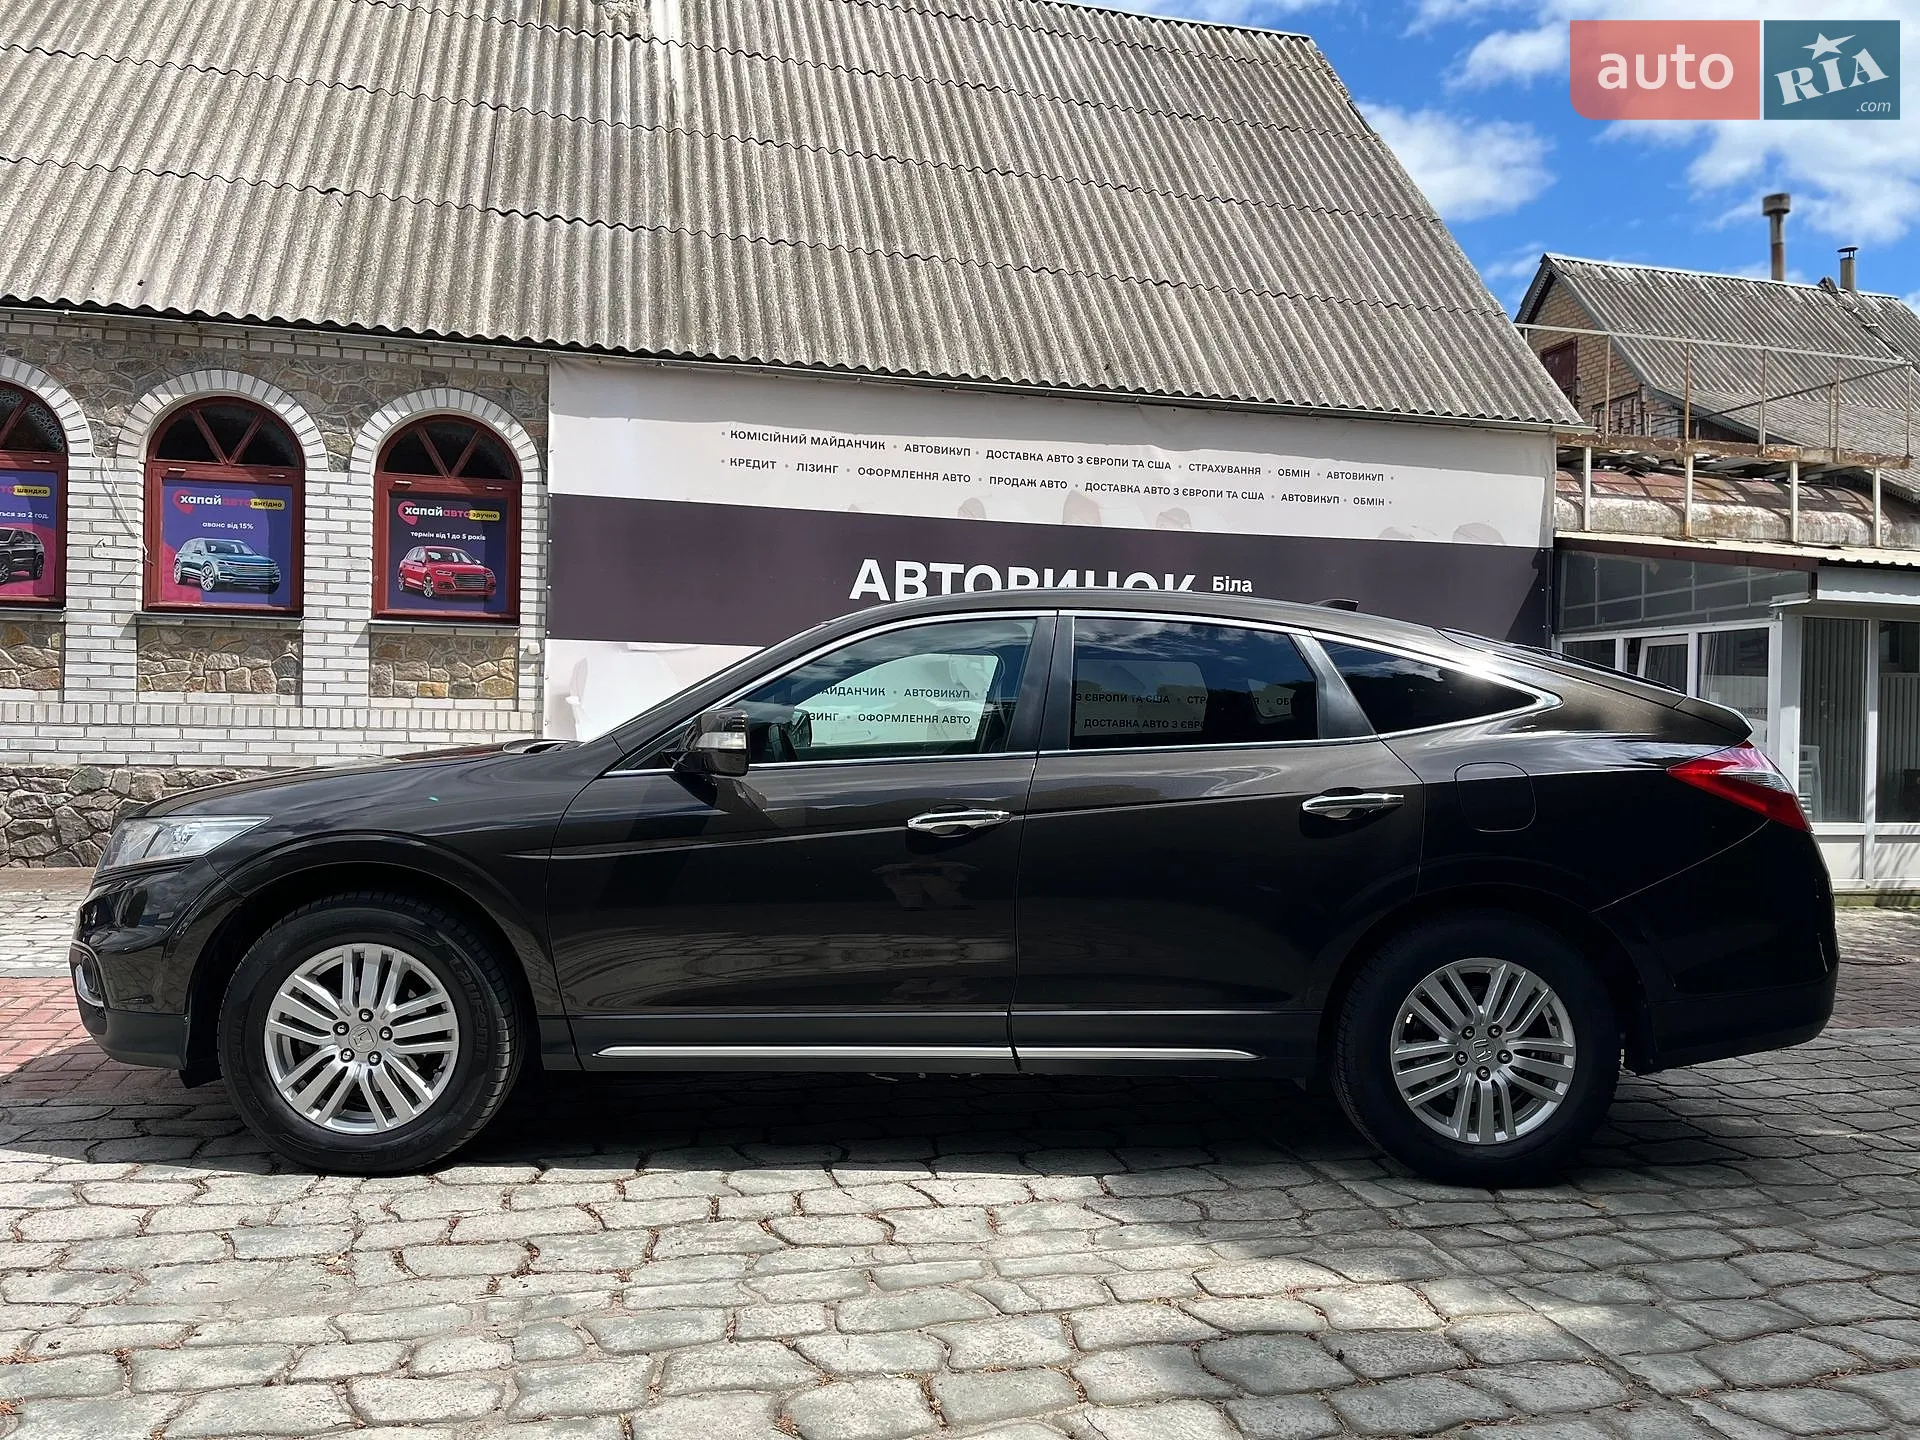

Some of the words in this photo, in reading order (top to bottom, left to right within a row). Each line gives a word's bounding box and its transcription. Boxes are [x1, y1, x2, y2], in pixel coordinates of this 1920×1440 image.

[730, 430, 807, 445] КОМІСІЙНИЙ
[811, 436, 886, 450] МАЙДАНЧИК
[904, 443, 971, 457] АВТОВИКУП
[986, 449, 1043, 462] ДОСТАВКА
[1046, 454, 1074, 464] АВТО
[1077, 455, 1084, 464] З
[1086, 456, 1129, 468] ЄВРОПИ
[1132, 459, 1145, 469] ТА
[1147, 460, 1171, 470] США
[1188, 463, 1261, 476] СТРАХУВАННЯ
[1277, 468, 1310, 478] ОБМІН
[1326, 471, 1384, 482] АВТОВИКУП
[730, 457, 776, 470] КРЕДИТ
[796, 462, 839, 474] ЛІЗИНГ
[857, 466, 939, 481] ОФОРМЛЕННЯ
[942, 473, 971, 483] АВТО
[989, 476, 1037, 488] ПРОДАЖ
[1040, 479, 1068, 489] АВТО
[1085, 482, 1141, 494] ДОСТАВКА
[1143, 485, 1170, 496] АВТО
[1173, 487, 1180, 496] З
[1182, 487, 1223, 498] ЄВРОПИ
[1226, 490, 1238, 499] ТА
[1241, 491, 1265, 501] США
[1280, 493, 1340, 504] АВТОВИКУП
[1353, 497, 1385, 506] ОБМІН
[227, 522, 238, 530] від
[240, 522, 254, 530] 15%
[435, 531, 446, 539] від
[1212, 576, 1252, 593] Біла
[818, 686, 885, 697] АЙДАНЧИК
[904, 688, 970, 699] АВТОВИКУП
[1085, 693, 1128, 703] ЄВРОПИ
[1146, 694, 1170, 704] США
[858, 713, 939, 724] ОФОРМЛЕННЯ
[942, 715, 971, 724] АВТО
[1084, 719, 1139, 729] ДОСТАВКА
[1142, 719, 1169, 729] АВТО
